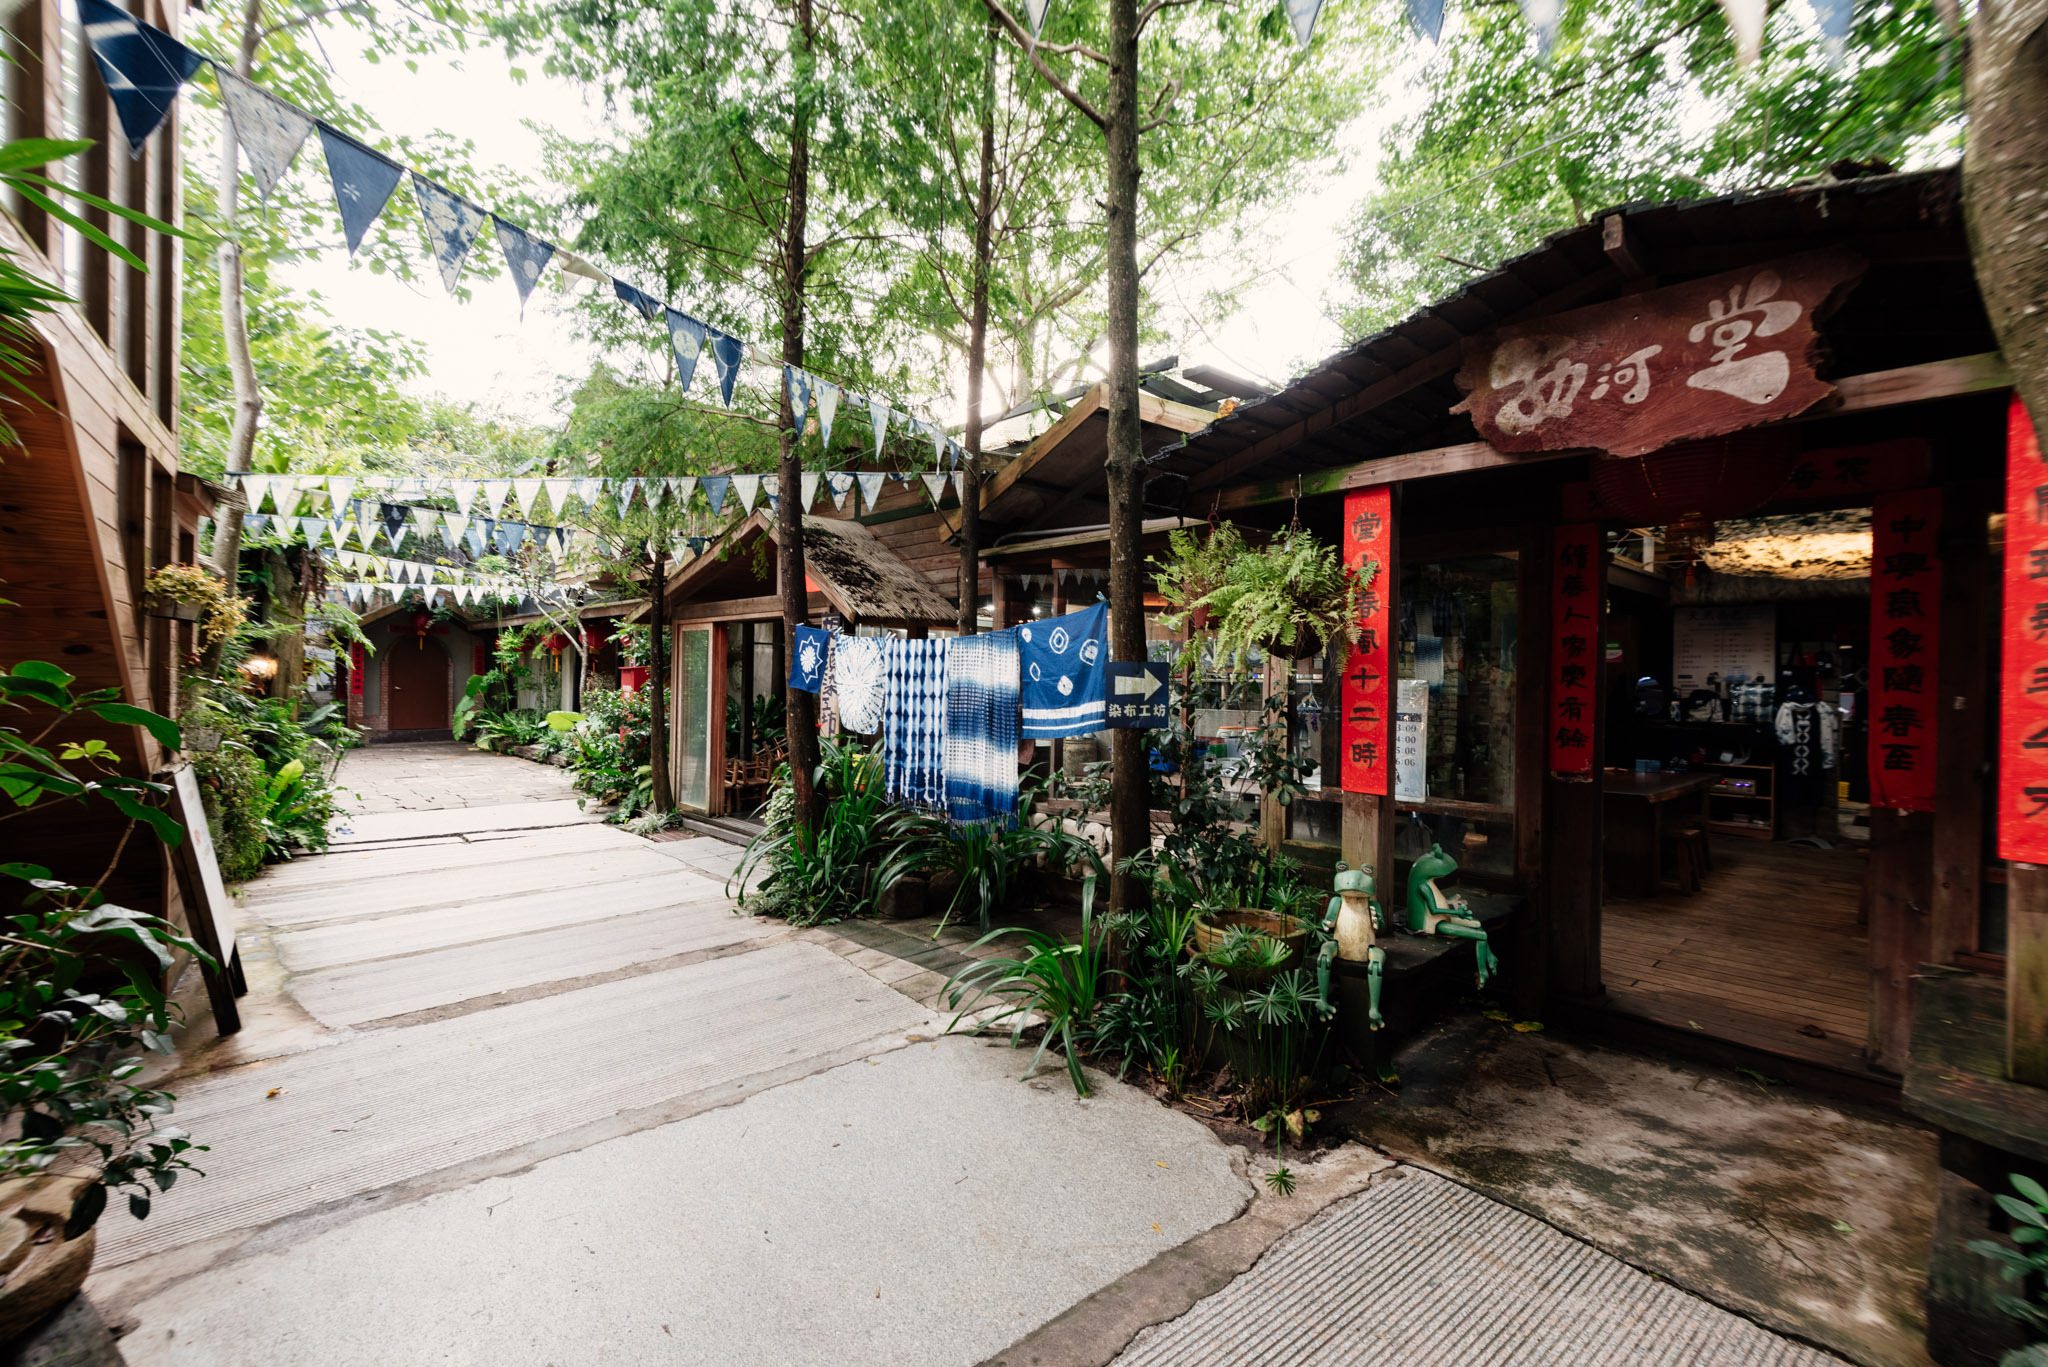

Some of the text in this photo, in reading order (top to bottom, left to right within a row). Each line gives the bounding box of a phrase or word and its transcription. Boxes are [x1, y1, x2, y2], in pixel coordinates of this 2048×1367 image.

[1348, 513, 1381, 769] 堂上春風十二時
[1108, 703, 1166, 718] 染布工坊
